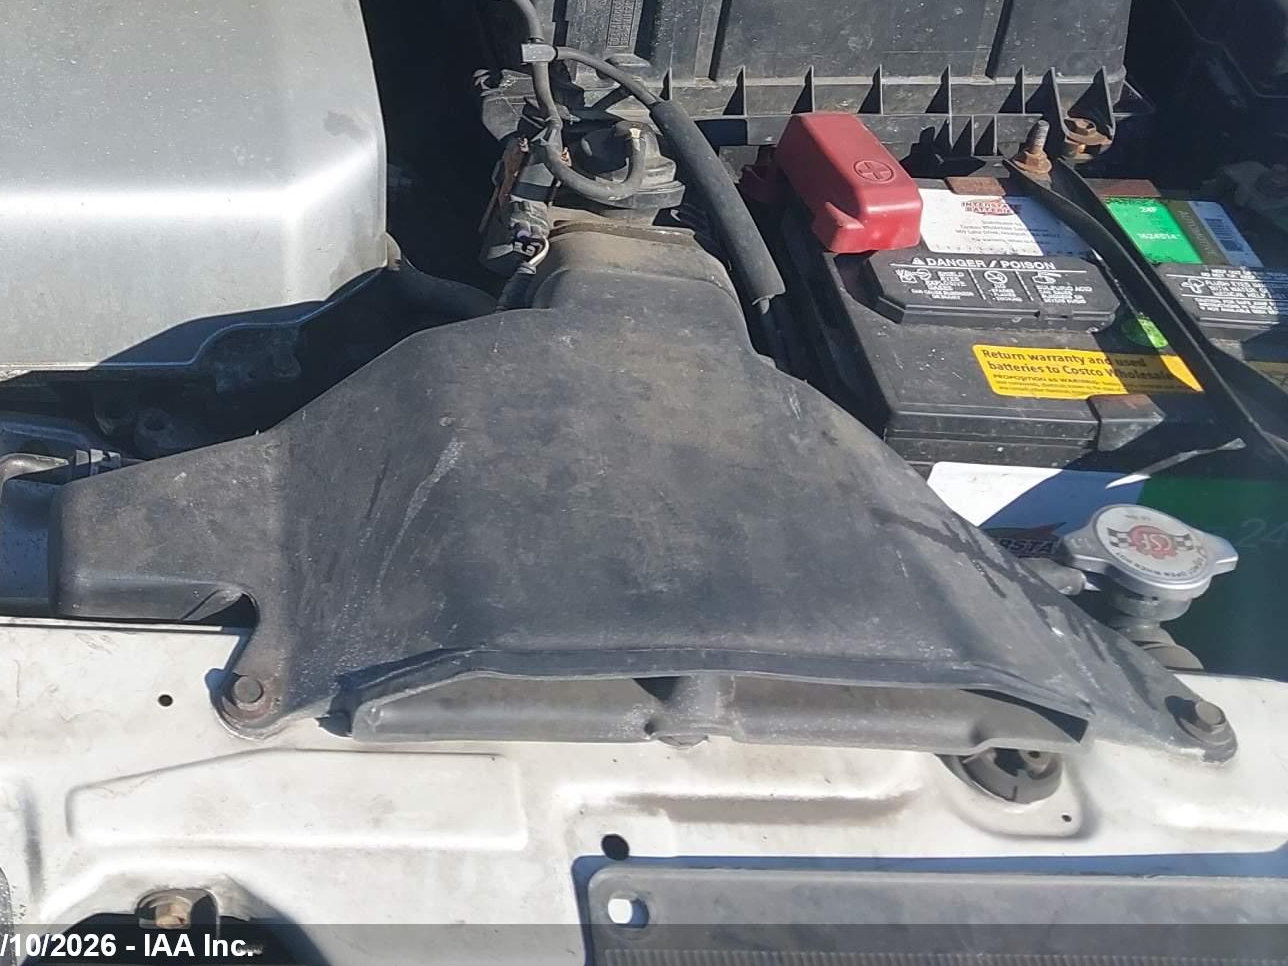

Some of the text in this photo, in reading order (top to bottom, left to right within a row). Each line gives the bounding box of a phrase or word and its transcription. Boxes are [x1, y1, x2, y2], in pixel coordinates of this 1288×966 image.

[925, 258, 987, 269] DANGER
[1000, 260, 1056, 271] POISON
[982, 349, 1147, 368] Return warranty and used
[987, 360, 1044, 374] batteries
[1047, 364, 1061, 374] to
[1062, 365, 1104, 377] Costco
